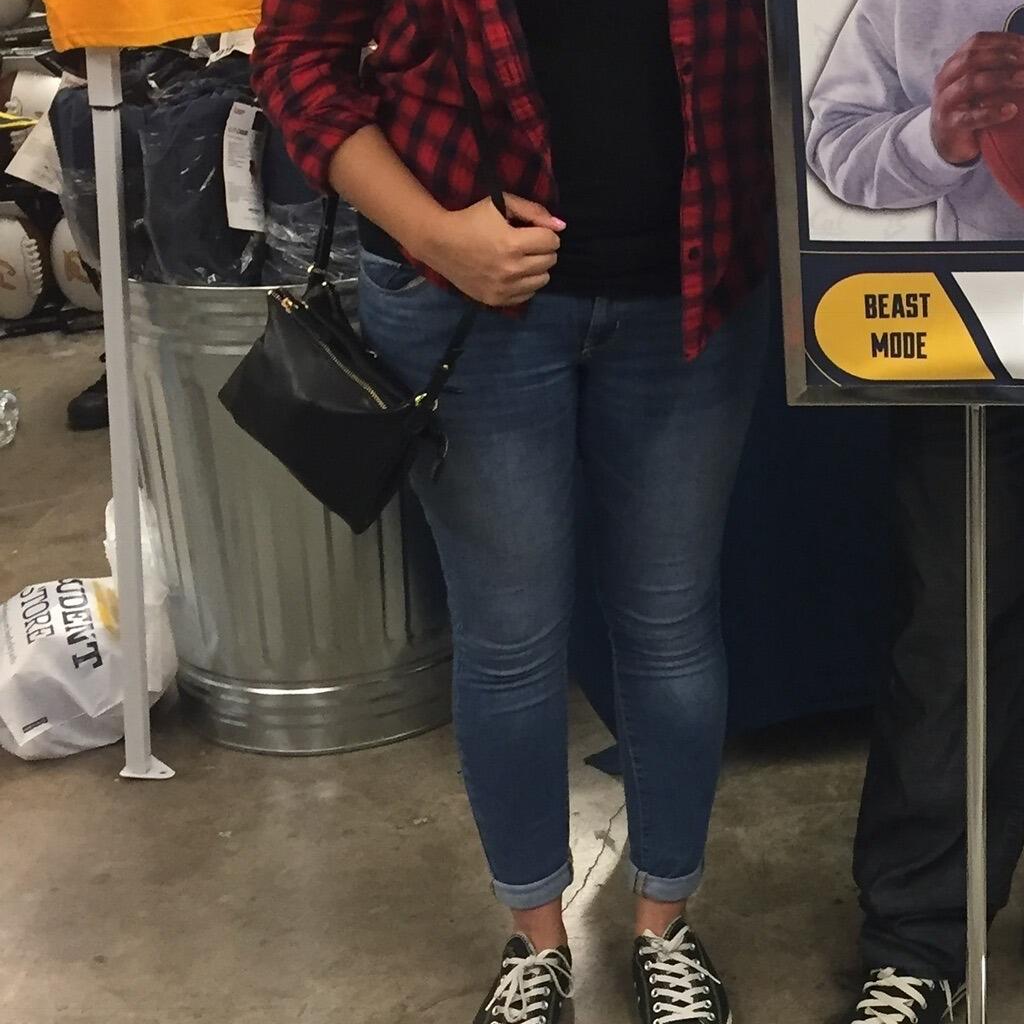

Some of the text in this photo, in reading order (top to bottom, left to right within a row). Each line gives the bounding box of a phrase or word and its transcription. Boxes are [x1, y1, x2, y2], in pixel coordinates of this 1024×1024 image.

[864, 292, 930, 319] BEAST
[871, 332, 928, 359] MODE
[56, 578, 103, 669] UDENT
